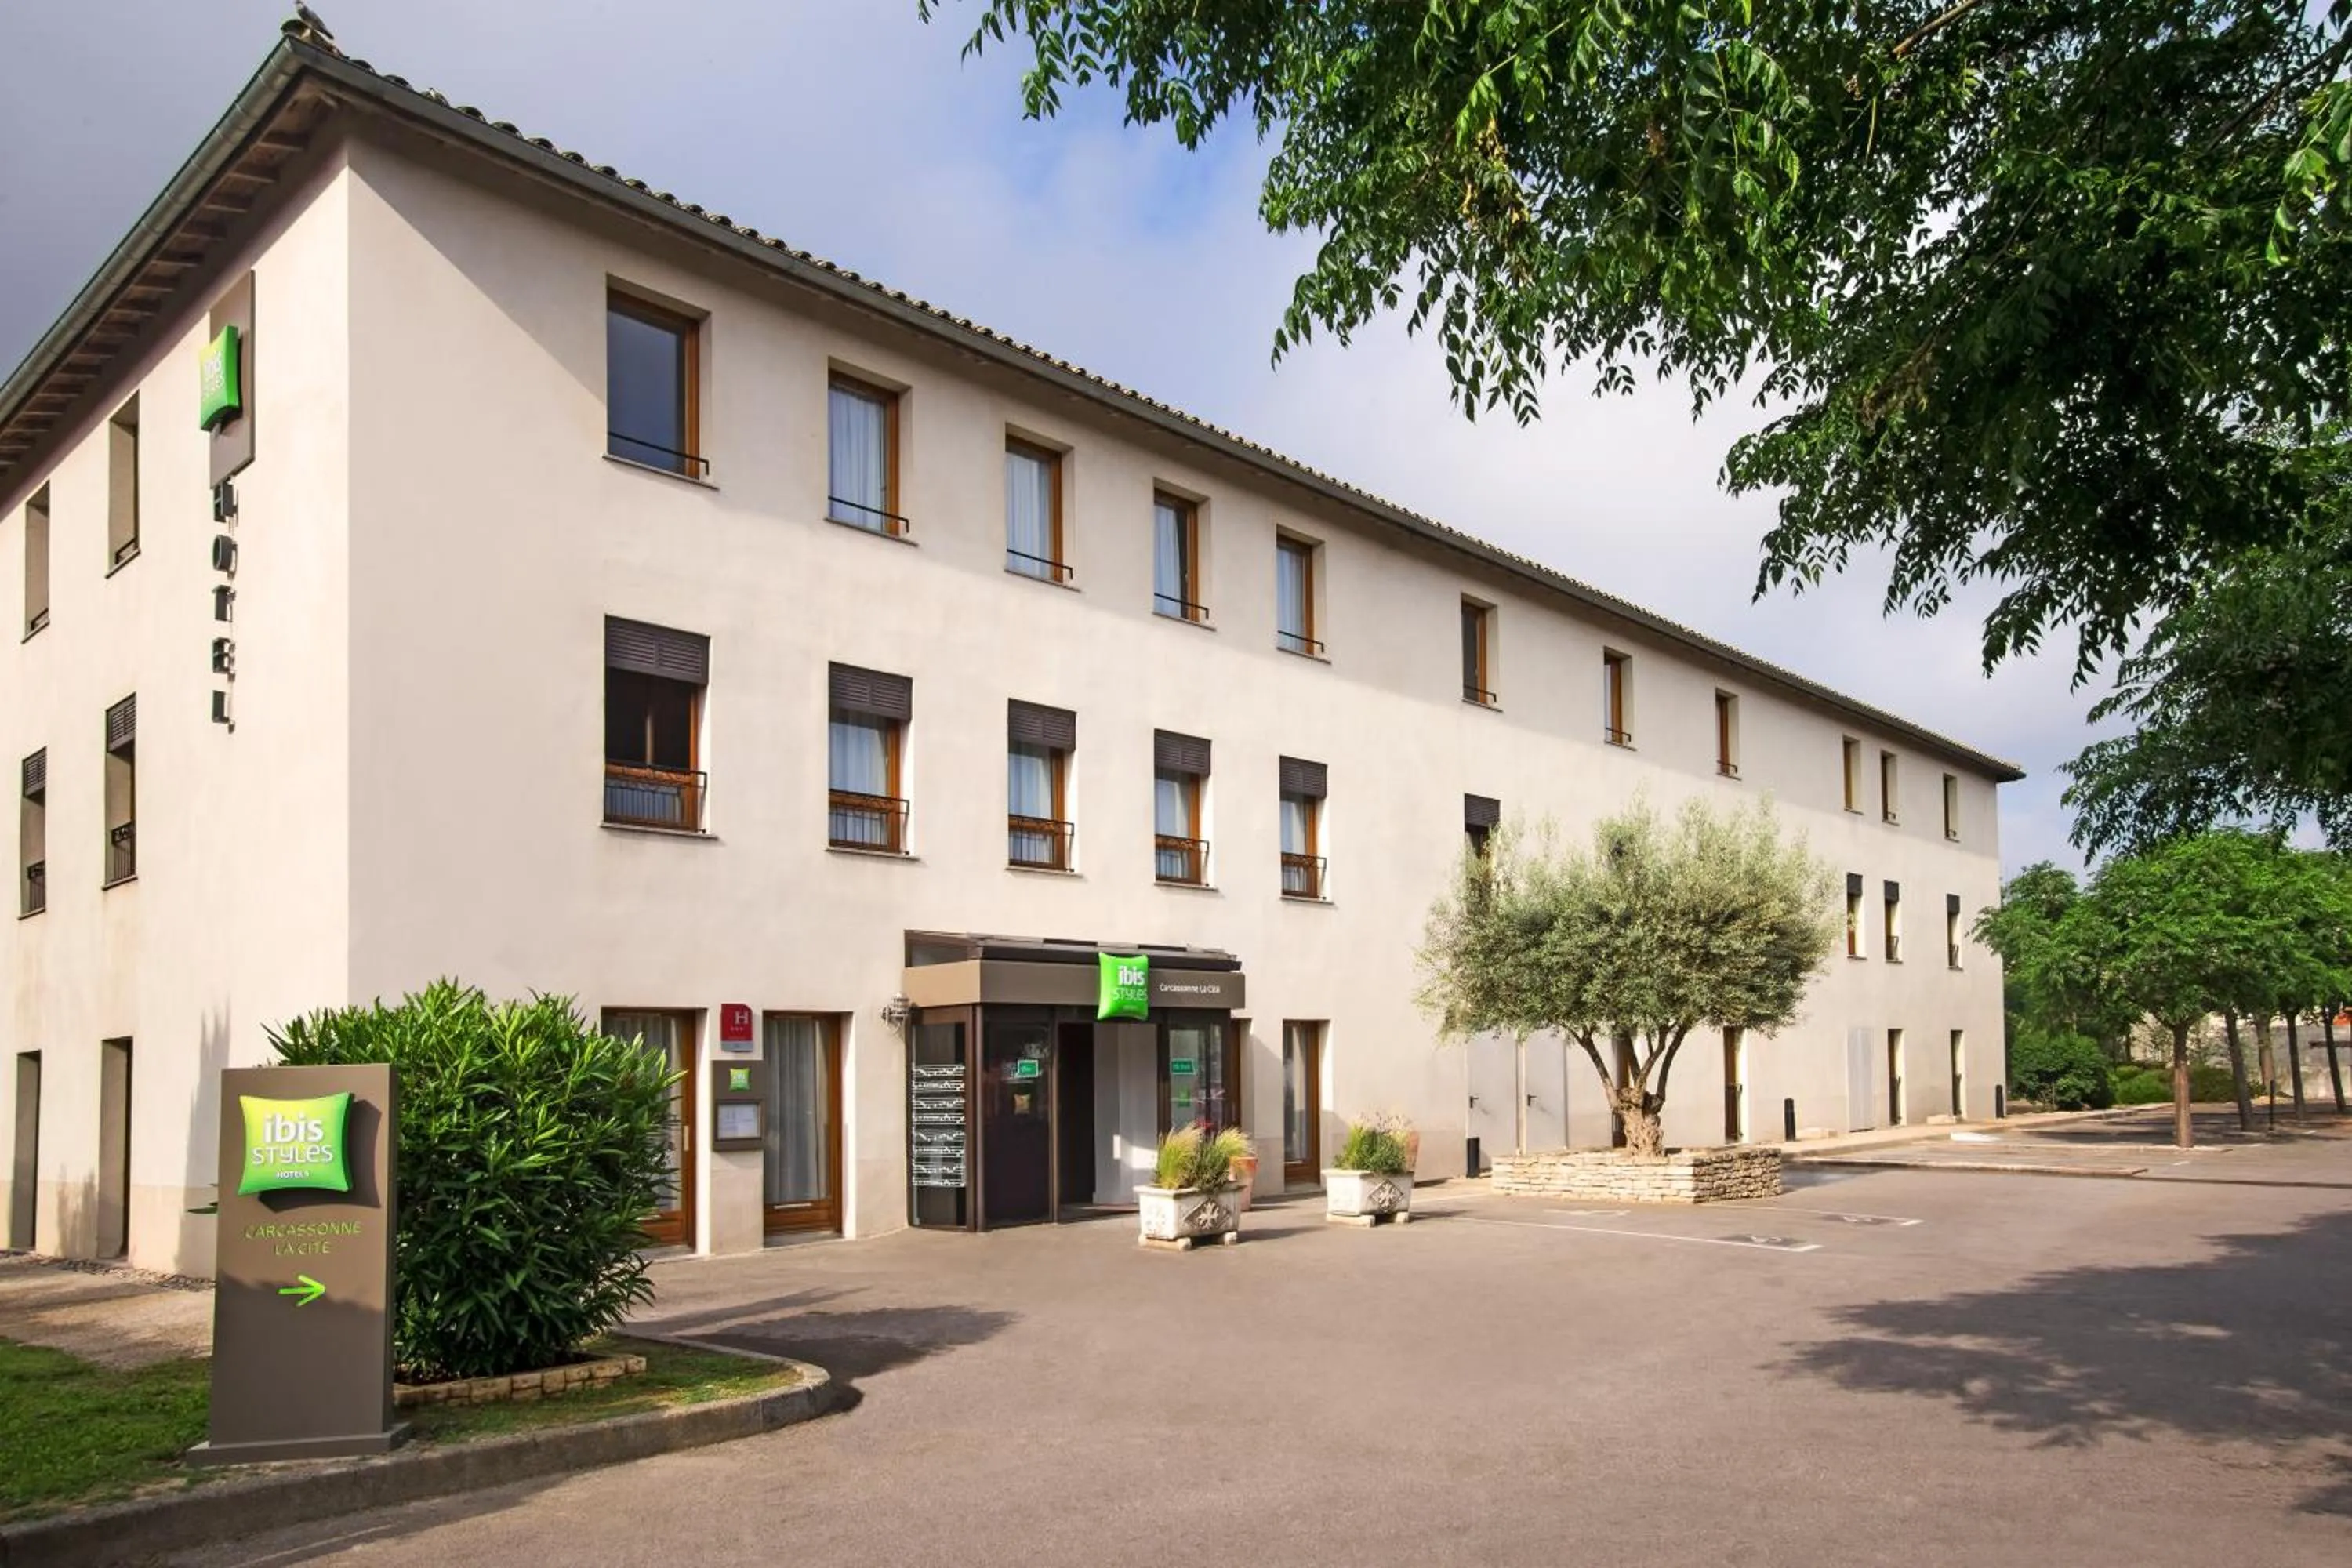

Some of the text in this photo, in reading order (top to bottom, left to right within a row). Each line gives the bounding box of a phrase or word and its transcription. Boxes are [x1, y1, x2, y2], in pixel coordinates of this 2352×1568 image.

[1119, 966, 1145, 985] ibis
[735, 1011, 749, 1025] H
[263, 1112, 324, 1143] ibis
[245, 1221, 362, 1239] CARCASSONNE
[274, 1243, 295, 1255] LA
